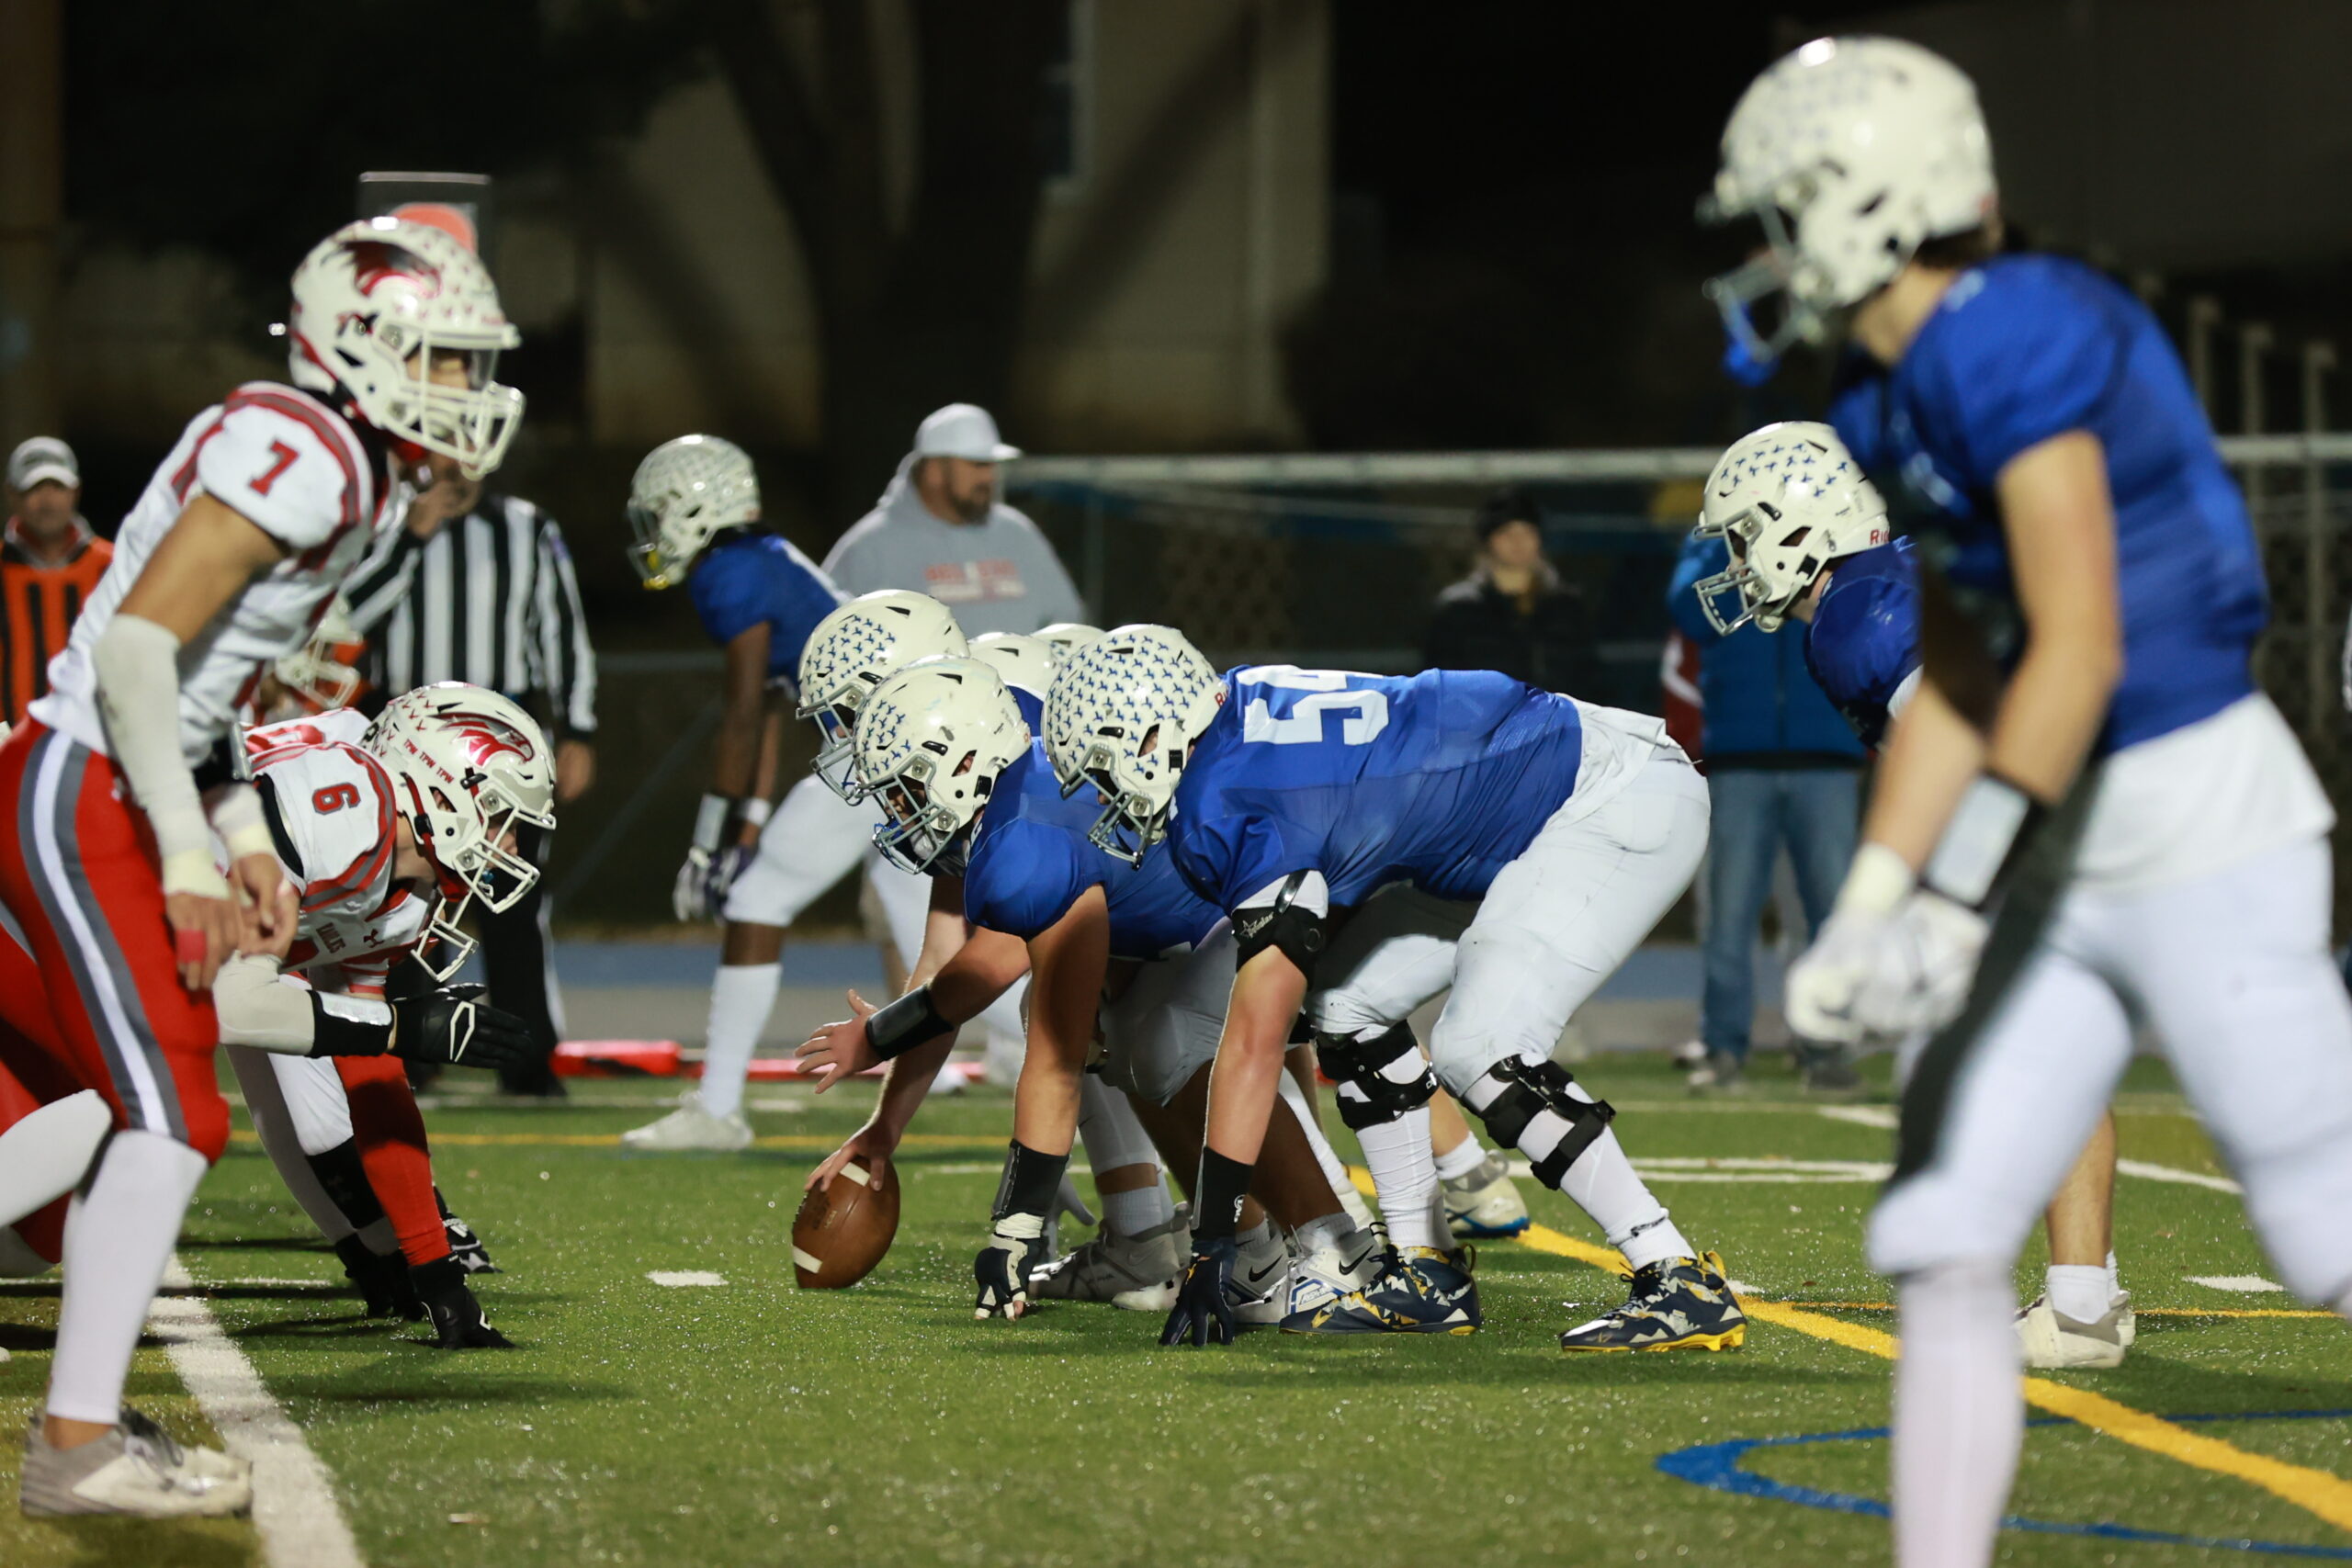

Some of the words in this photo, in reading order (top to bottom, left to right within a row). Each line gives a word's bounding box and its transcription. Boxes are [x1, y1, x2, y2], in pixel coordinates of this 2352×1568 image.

[247, 438, 300, 498] 7
[1236, 664, 1389, 746] 54
[403, 739, 419, 755] TPW
[419, 750, 436, 769] TPW
[435, 766, 455, 784] TPW
[311, 782, 361, 816] 6
